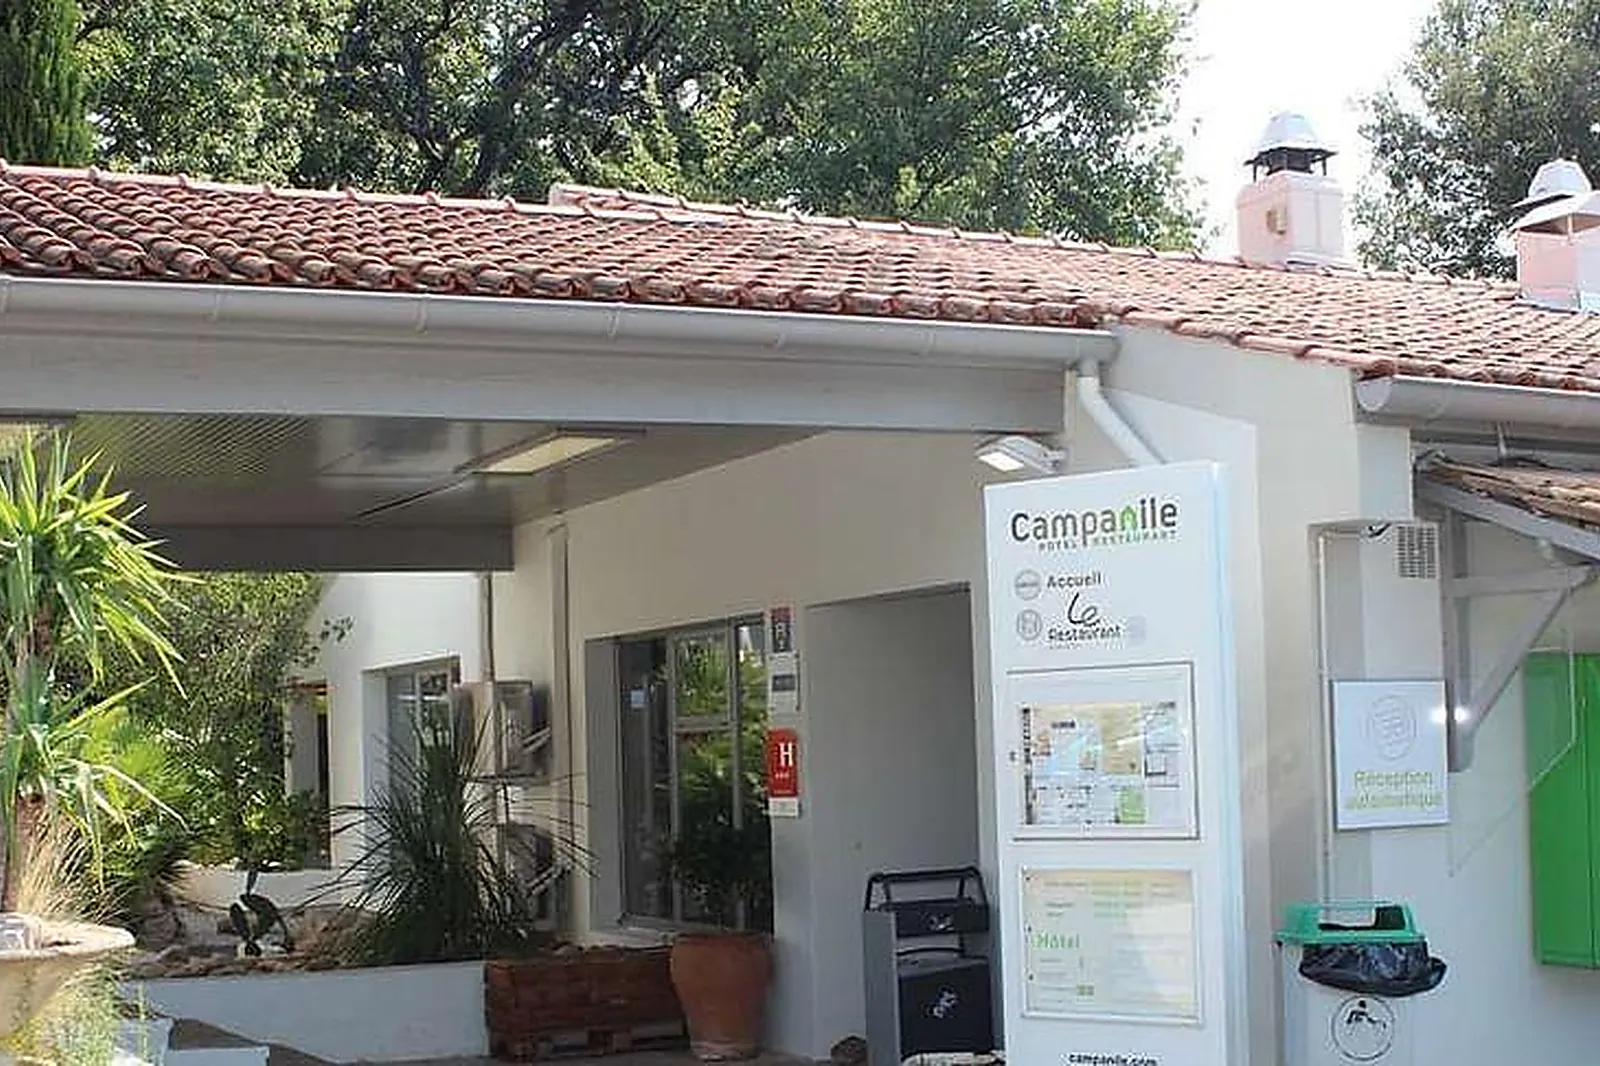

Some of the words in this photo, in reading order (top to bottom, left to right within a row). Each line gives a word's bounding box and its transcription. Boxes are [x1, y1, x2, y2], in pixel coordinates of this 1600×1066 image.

[1011, 497, 1178, 546] Campanile
[1047, 571, 1102, 588] Accueil
[1048, 625, 1122, 641] Restaurant
[779, 742, 793, 767] H
